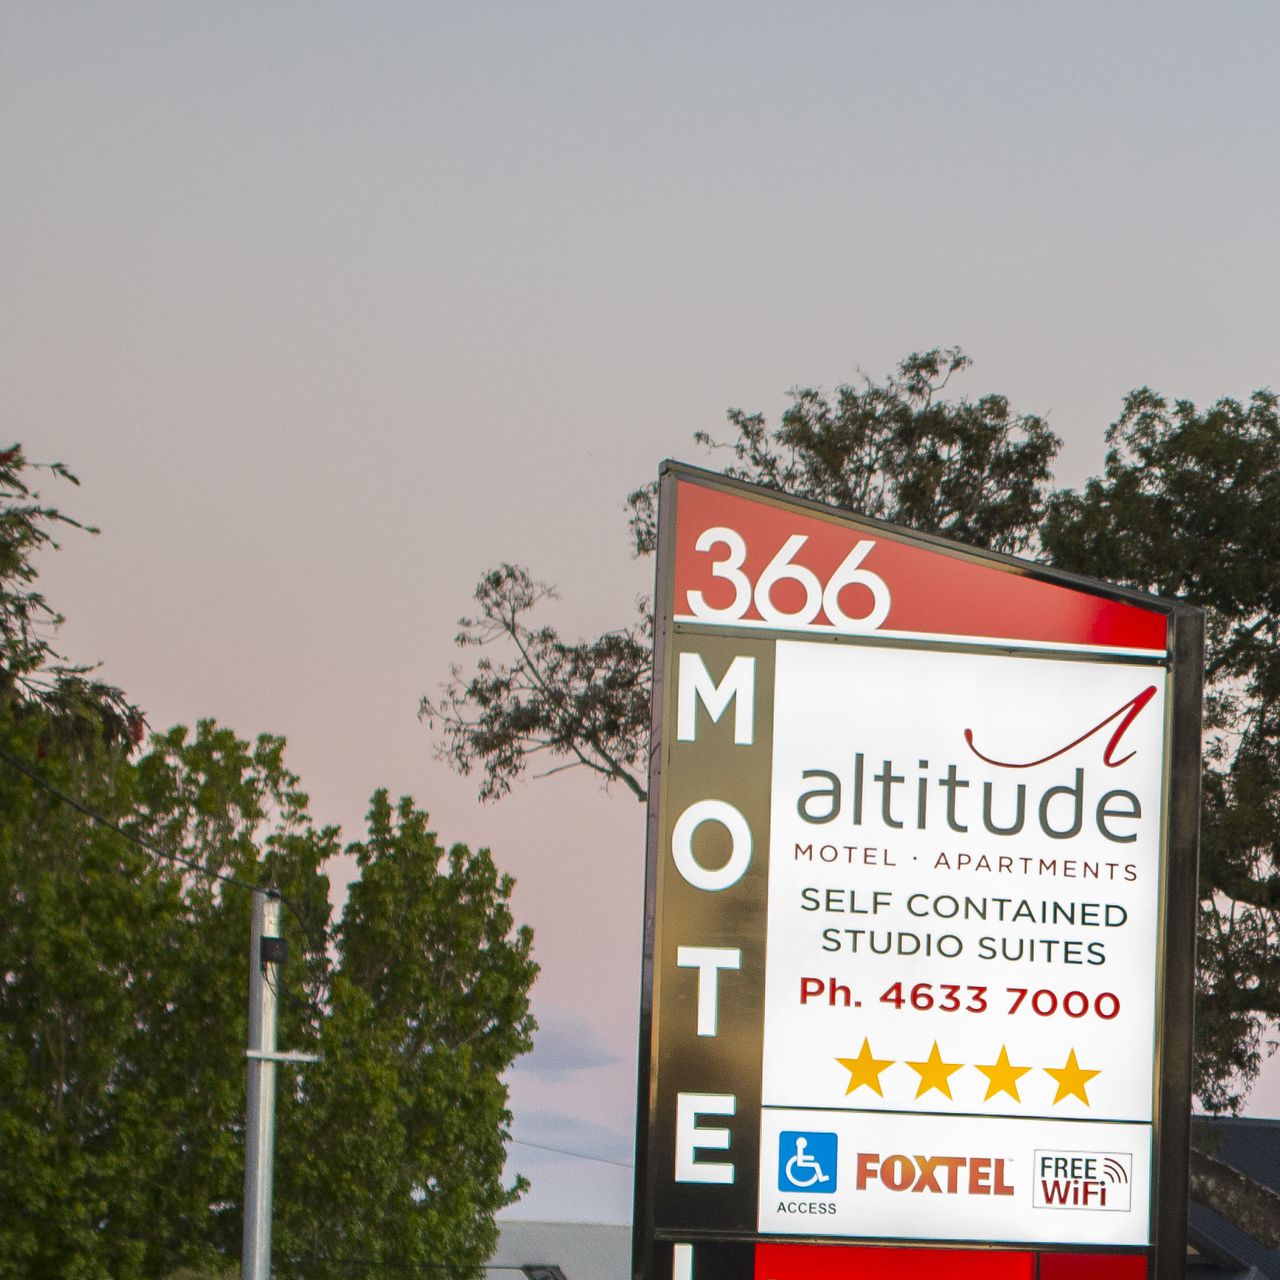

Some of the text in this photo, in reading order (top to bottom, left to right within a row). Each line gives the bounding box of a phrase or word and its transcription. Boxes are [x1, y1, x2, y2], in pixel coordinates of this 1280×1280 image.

[686, 527, 891, 631] 366
[796, 752, 1143, 844] altitude
[795, 843, 1139, 882] MOTEL APARTMENTS
[801, 887, 1128, 929] SELF CONTAINED
[822, 928, 1107, 966] STUDIO SUITES
[800, 977, 1122, 1021] Ph. 4633 7000
[856, 1153, 1015, 1197] FOXTEL
[1041, 1157, 1098, 1180] FREE
[777, 1202, 838, 1216] ACCESS
[1041, 1180, 1108, 1207] WiFi
